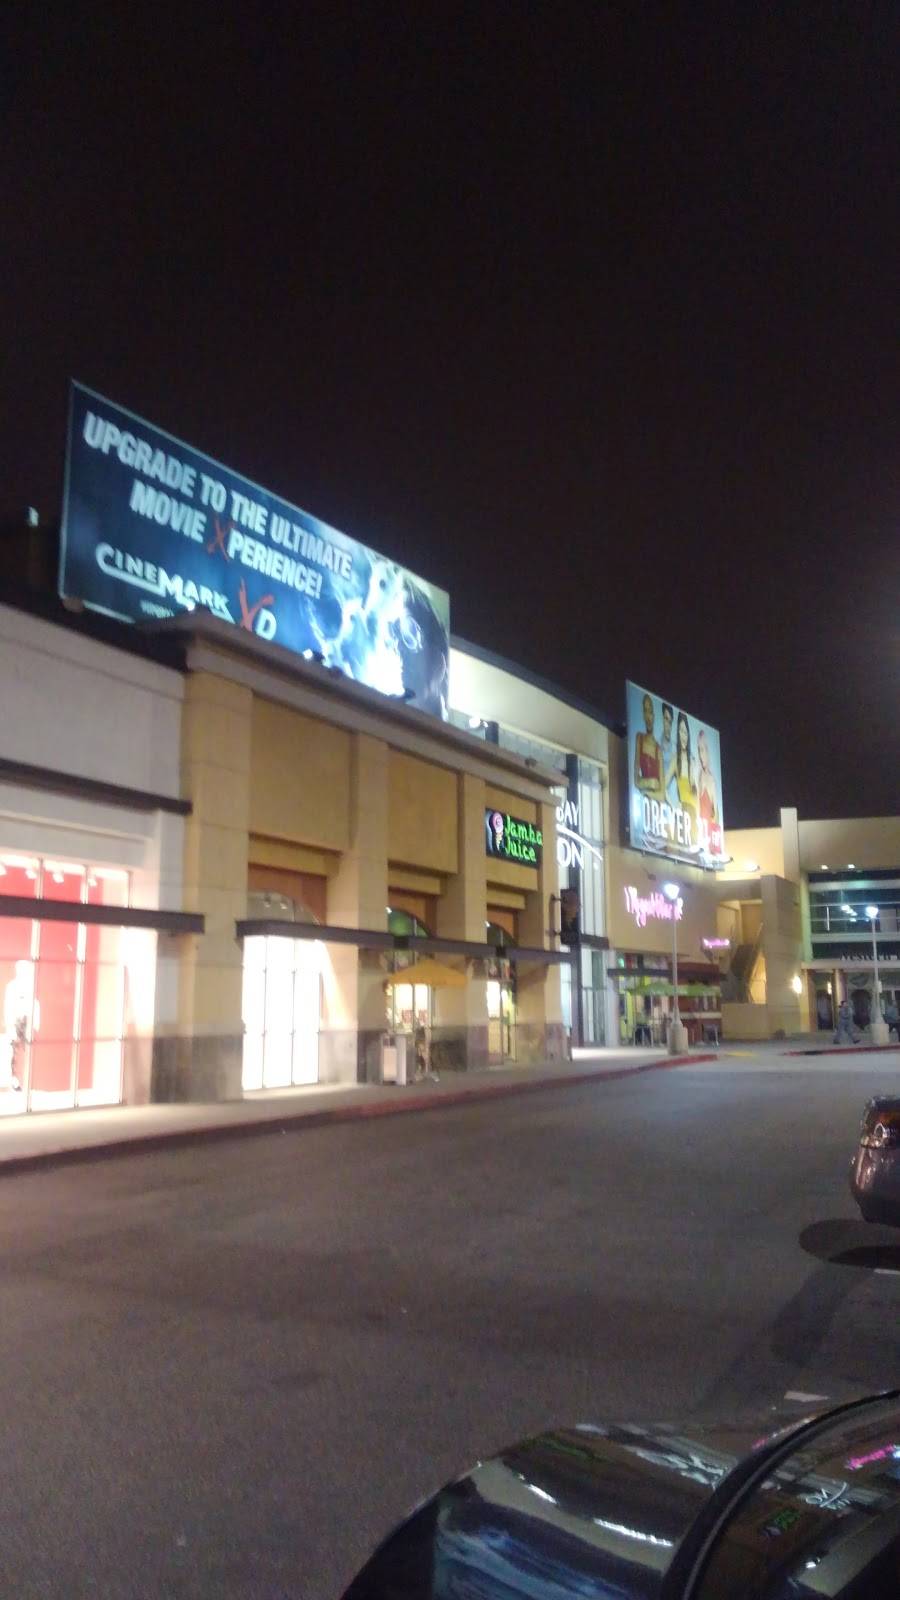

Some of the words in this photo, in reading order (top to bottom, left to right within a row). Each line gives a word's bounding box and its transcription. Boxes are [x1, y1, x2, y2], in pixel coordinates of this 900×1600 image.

[83, 411, 197, 498] UPGRADE
[200, 472, 227, 513] TO
[230, 489, 269, 537] THE
[269, 512, 353, 580] ULTIMATE
[129, 479, 207, 543] MOVIE
[96, 542, 236, 624] CINEMARK
[505, 815, 543, 847] Jamba
[505, 836, 537, 862] Juice
[640, 793, 692, 847] OREVER
